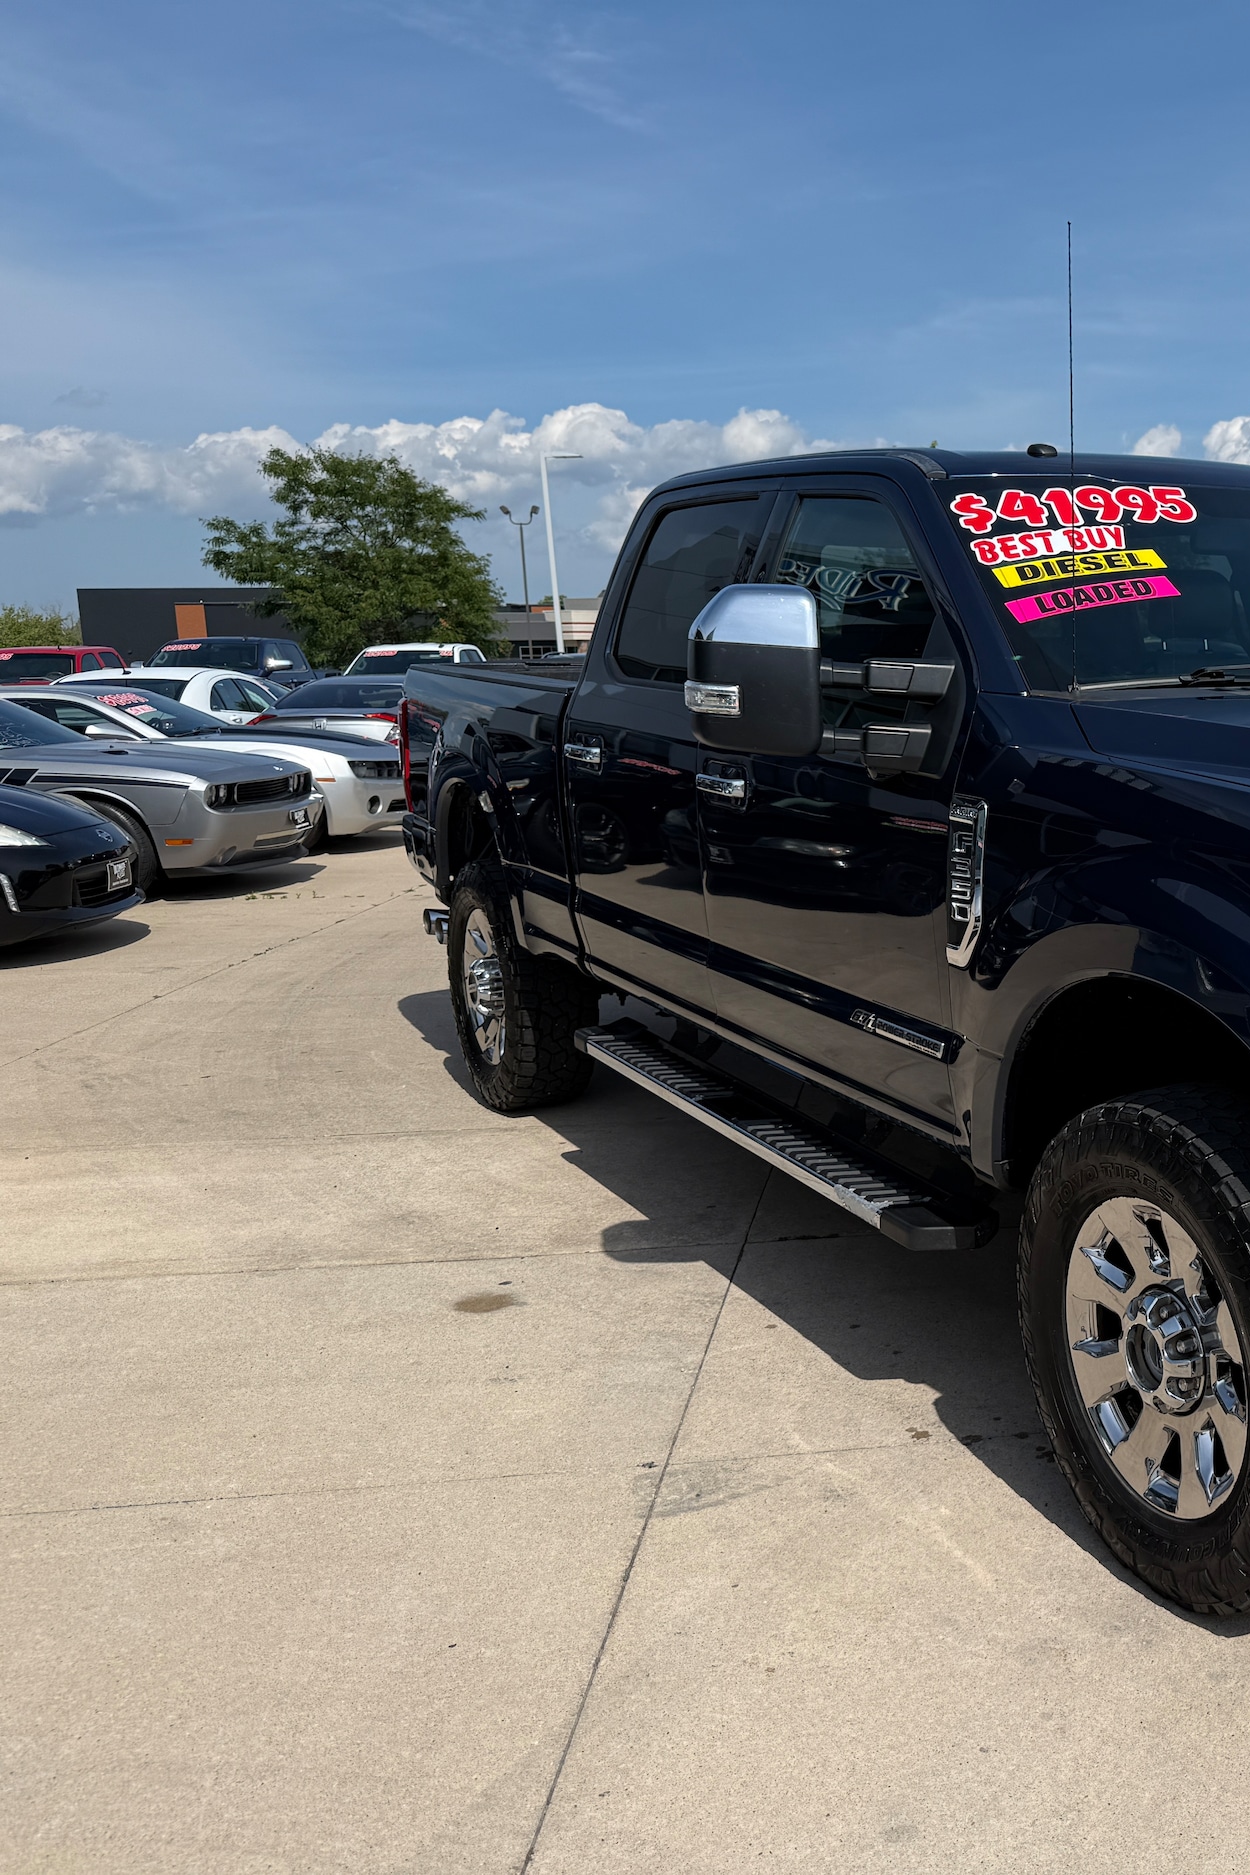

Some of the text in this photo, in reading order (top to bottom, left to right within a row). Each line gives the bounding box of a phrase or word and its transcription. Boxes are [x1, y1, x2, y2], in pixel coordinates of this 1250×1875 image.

[951, 486, 1197, 533] $41995
[973, 527, 1123, 563] BEST BUY
[1015, 551, 1152, 583] DIESEL
[1034, 579, 1156, 614] LOADED
[1099, 1162, 1175, 1206] TIRES
